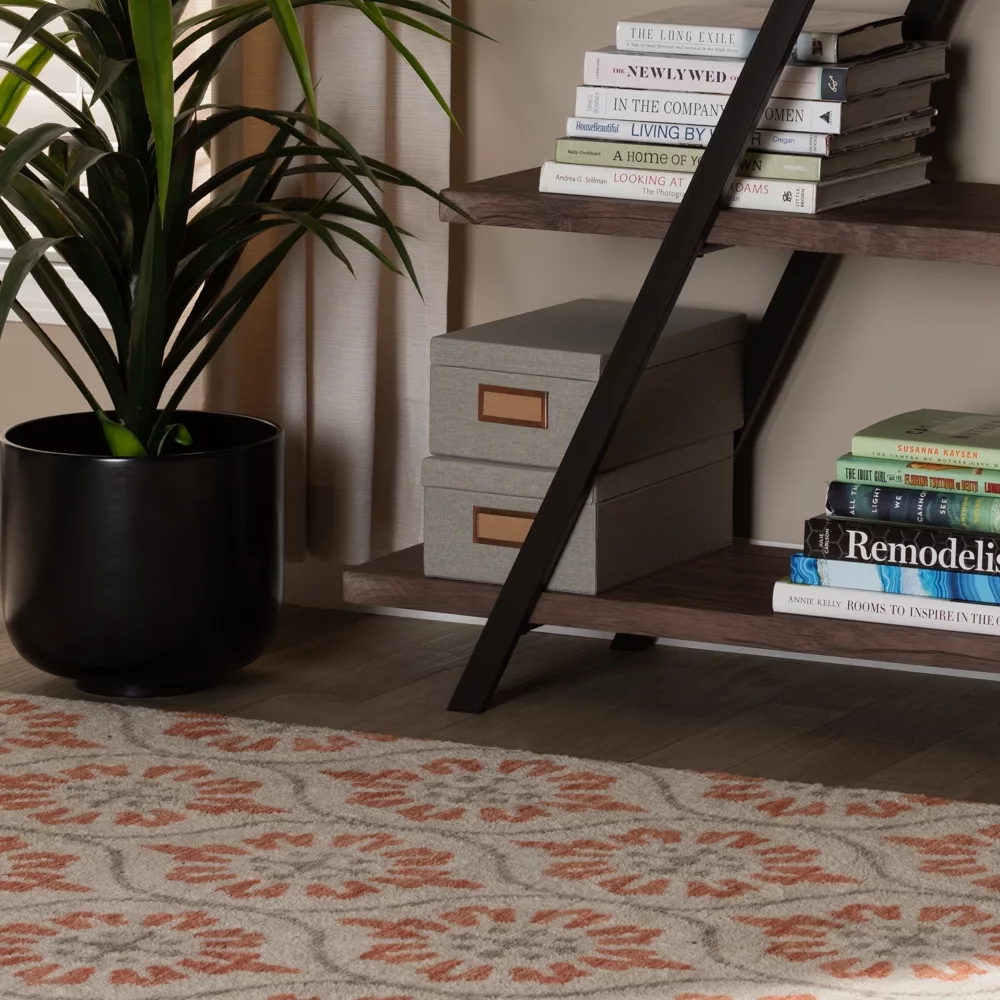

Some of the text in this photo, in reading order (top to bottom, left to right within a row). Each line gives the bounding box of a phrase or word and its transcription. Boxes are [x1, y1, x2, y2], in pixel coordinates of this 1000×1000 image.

[630, 27, 736, 45] THE LONG EXILE
[626, 65, 727, 83] NEWLYWED
[613, 97, 628, 111] IN
[632, 99, 660, 114] THE
[764, 107, 805, 123] OMEN
[631, 123, 680, 140] LIVING
[685, 126, 706, 141] BY
[772, 135, 795, 145] Cregan
[612, 151, 623, 162] A
[671, 154, 687, 166] OF
[740, 160, 763, 171] WN
[554, 174, 576, 183] Andrea
[584, 176, 608, 185] Stillman
[613, 173, 666, 186] LOOKING
[669, 177, 684, 188] AT
[729, 182, 769, 195] ADAMS
[643, 187, 655, 196] The
[656, 188, 686, 199] Photogra
[897, 444, 979, 460] SUSANNA KAYSEN
[844, 467, 856, 480] THE
[857, 468, 873, 482] IDIOT
[873, 470, 887, 483] GIRL
[850, 485, 859, 496] TH
[871, 487, 882, 513] LIGHT
[894, 495, 902, 509] WE
[917, 491, 927, 523] CANNO
[940, 498, 948, 515] SEE
[788, 595, 814, 605] ANNIE
[817, 598, 842, 608] KELLY
[847, 600, 886, 614] ROOMS
[890, 604, 905, 616] TO
[910, 607, 954, 622] INSPIRE
[956, 611, 969, 623] IN
[971, 613, 994, 626] THE
